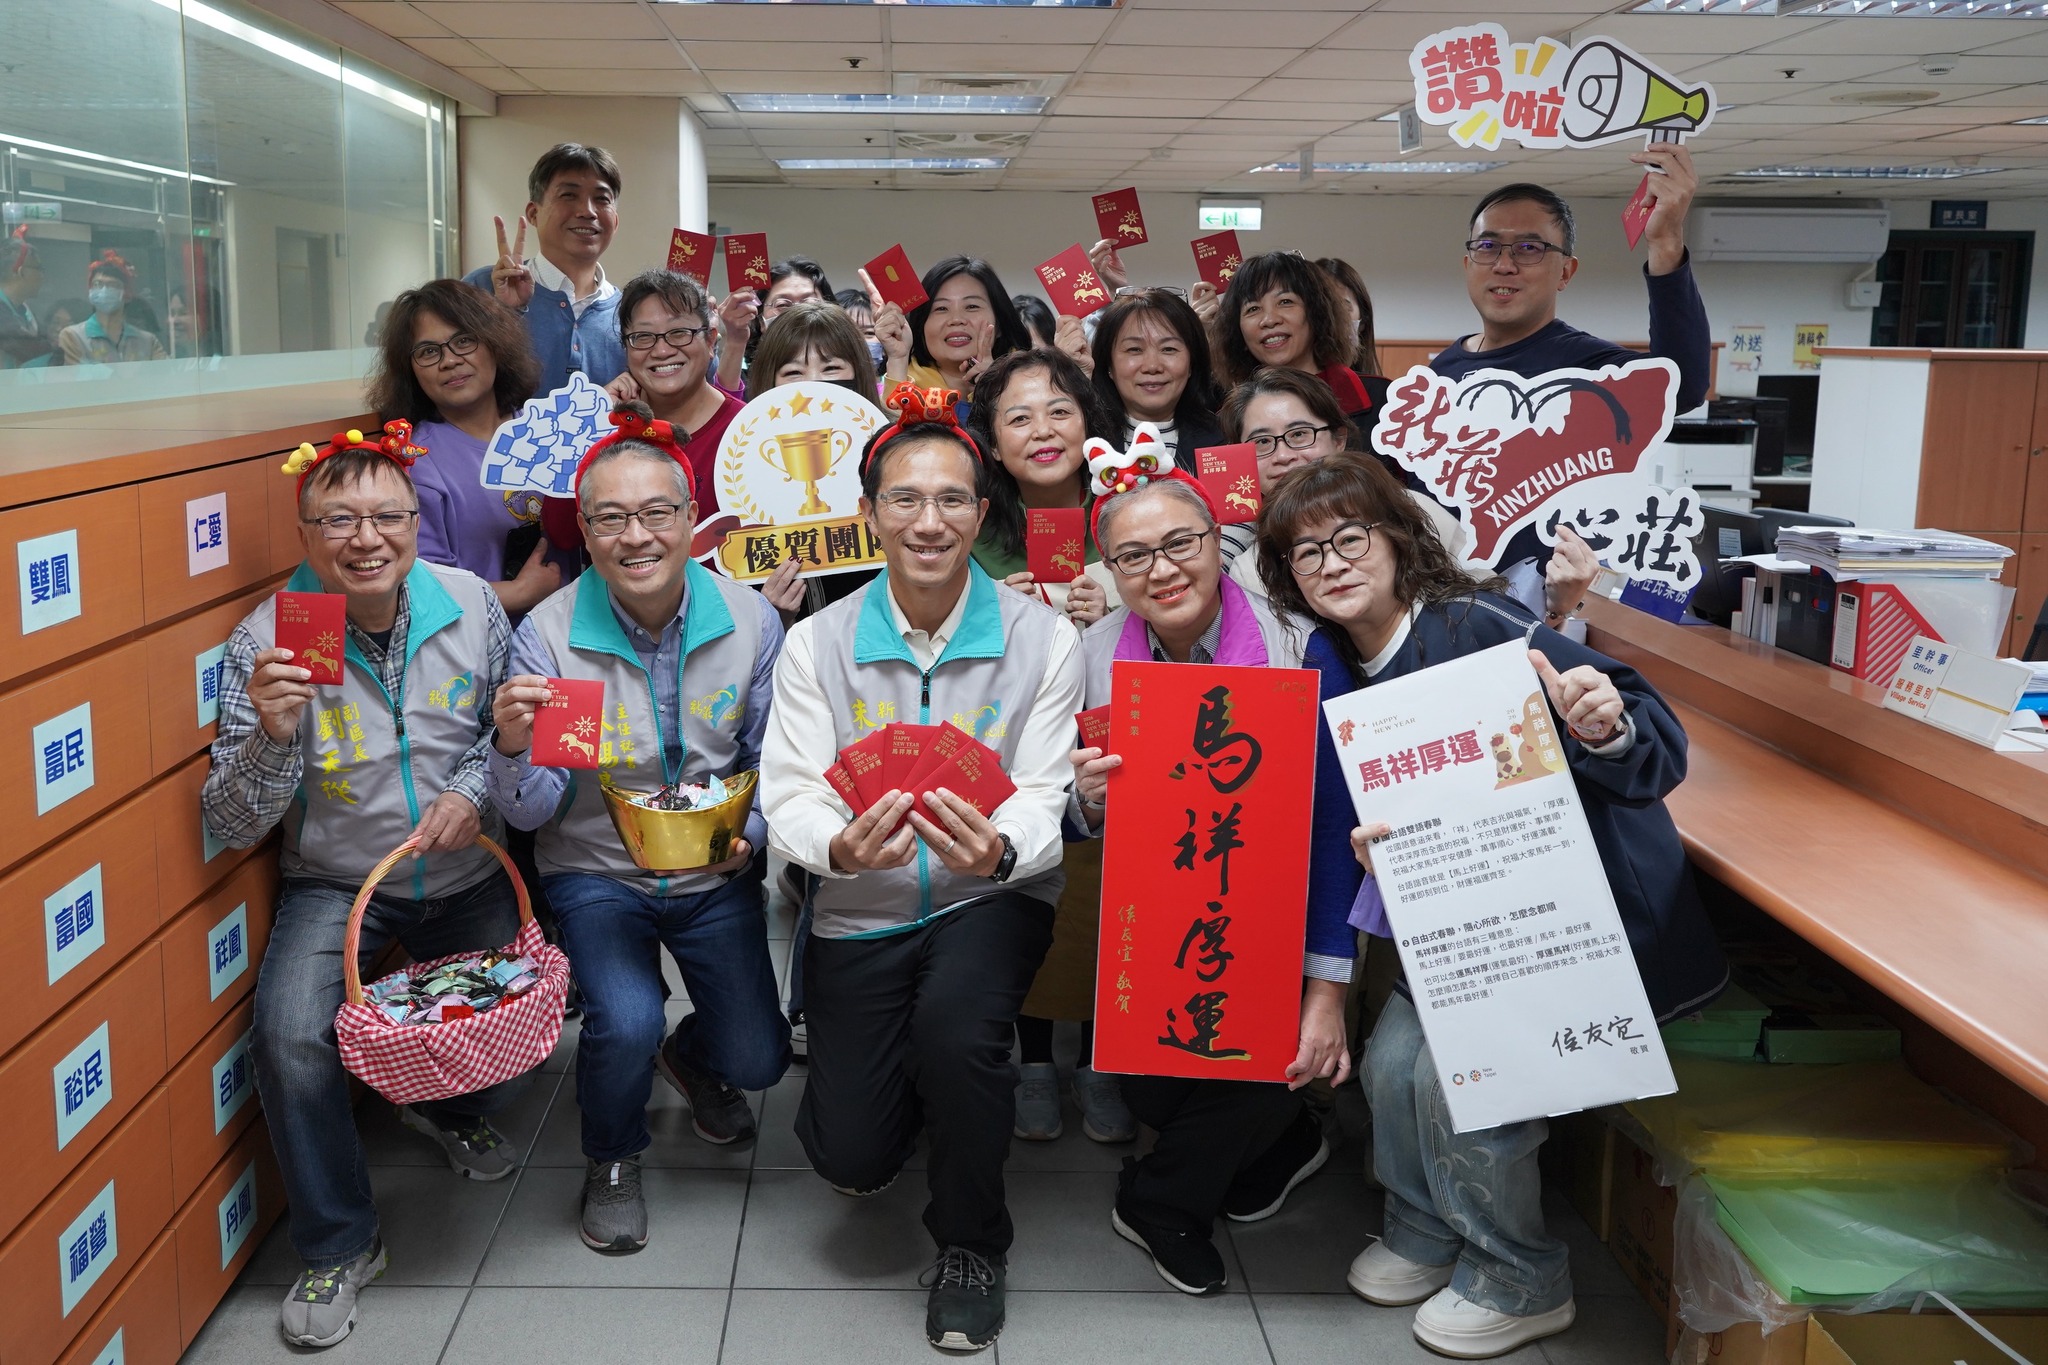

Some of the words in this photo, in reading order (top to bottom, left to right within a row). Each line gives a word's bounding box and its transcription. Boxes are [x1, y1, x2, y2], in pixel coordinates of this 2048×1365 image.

[1421, 33, 1565, 137] 讚啦
[1733, 335, 1762, 352] 外送
[1484, 447, 1614, 528] XINZHUANG
[194, 511, 222, 553] 仁愛
[743, 521, 882, 574] 優質團
[28, 553, 71, 605] 雙鳳
[1912, 646, 1949, 666] 里幹事
[1913, 663, 1934, 675] Officer
[1890, 691, 1906, 702] Village
[1908, 697, 1927, 709] Service
[1895, 678, 1934, 700] 服務里別
[342, 702, 369, 763] 副區長
[1372, 715, 1399, 727] HAPPY
[1374, 724, 1392, 734] NEW
[1393, 718, 1416, 729] YEAR
[1528, 701, 1558, 763] 馬祥厚運
[43, 727, 85, 785] 富民
[1358, 729, 1484, 793] 馬祥厚運
[1157, 685, 1263, 1060] 馬祥厚運
[54, 890, 94, 953] 富國
[215, 923, 242, 975] 祥鳳
[1483, 1071, 1498, 1079] Taipei
[1629, 1044, 1649, 1056] 敬賀
[64, 1048, 103, 1118] 裕民
[219, 1053, 246, 1108] 合鳳
[226, 1182, 251, 1243] 丹鳳
[69, 1210, 108, 1284] 福營
